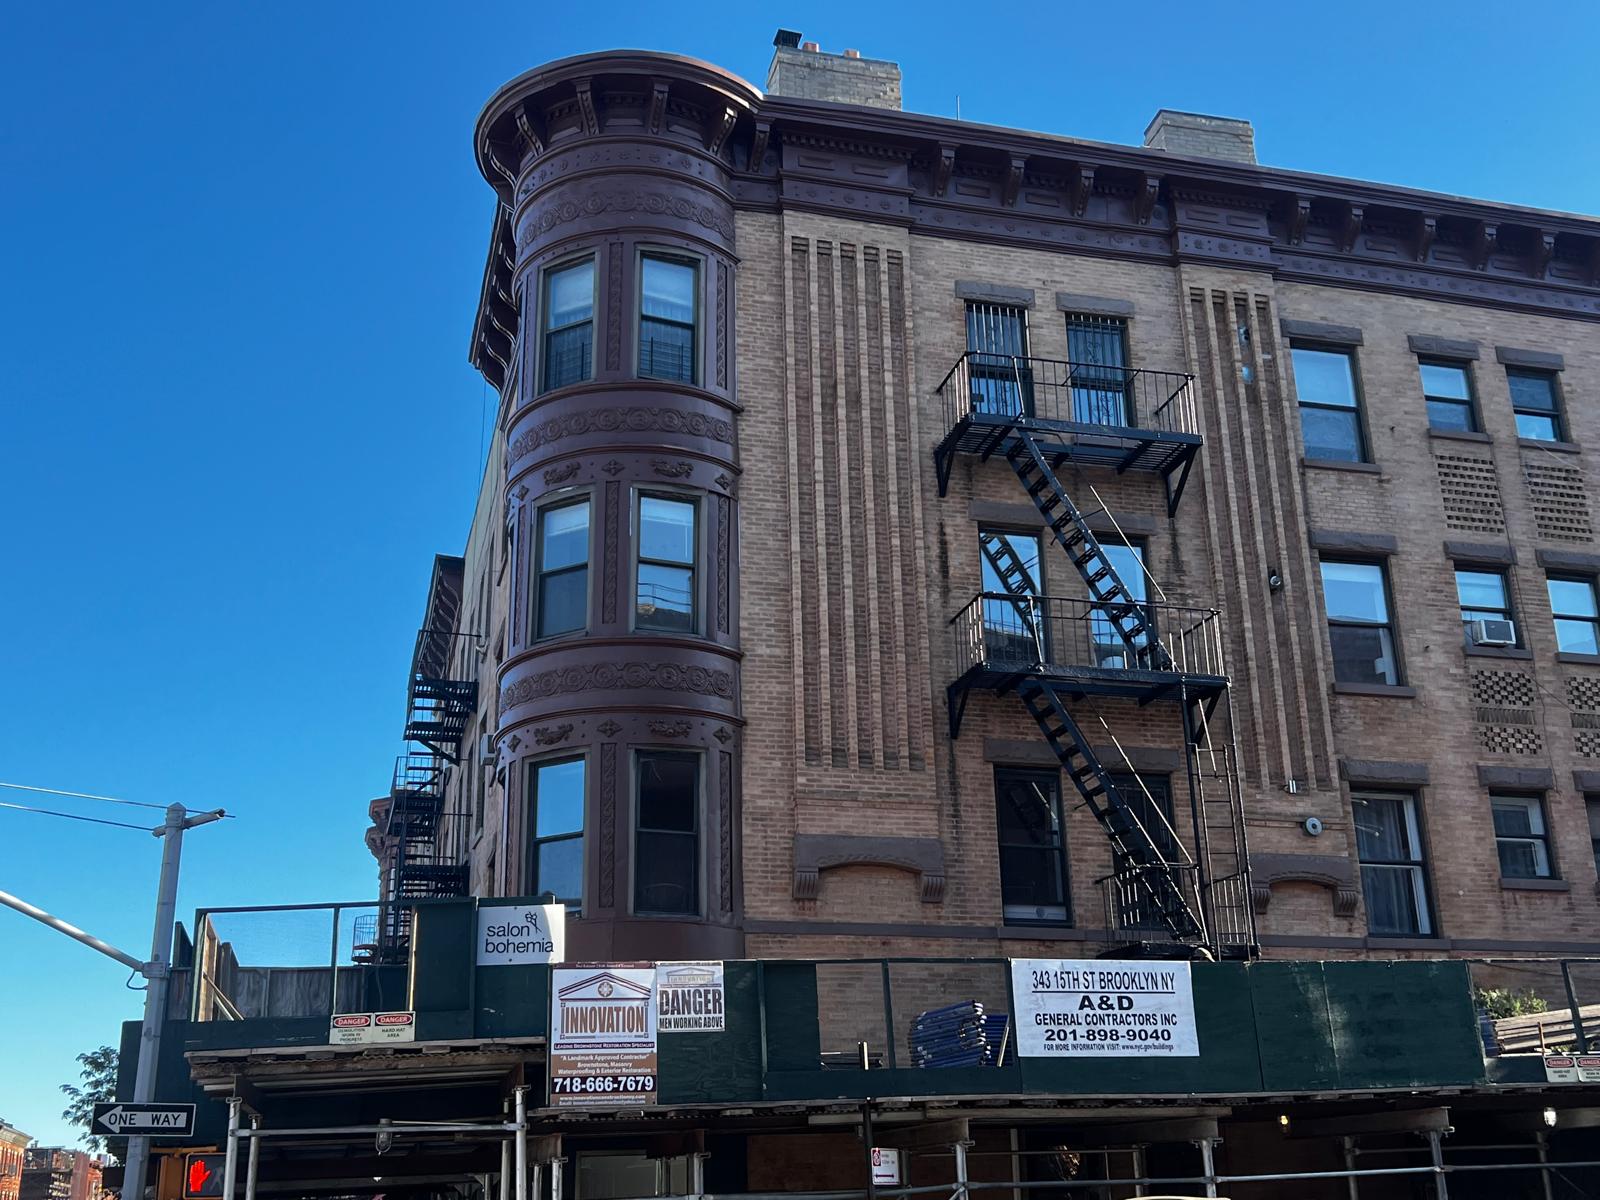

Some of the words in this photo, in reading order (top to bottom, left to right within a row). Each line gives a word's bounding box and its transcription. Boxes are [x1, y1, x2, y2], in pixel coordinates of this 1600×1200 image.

[486, 921, 530, 937] salon
[485, 937, 554, 954] bohemia
[1032, 970, 1051, 989] 343
[1053, 971, 1080, 990] 15TH
[1082, 971, 1096, 990] ST
[1099, 971, 1159, 991] BROOKLYN
[1161, 972, 1175, 991] NY
[660, 988, 723, 1016] DANGER
[1078, 995, 1134, 1011] A&D
[338, 1018, 366, 1026] DANGER
[380, 1016, 408, 1024] DANGER
[564, 1005, 645, 1034] INNOVATION
[660, 1017, 673, 1030] MEN
[673, 1016, 703, 1029] WORKING
[703, 1015, 723, 1029] ABOVE
[1035, 1013, 1083, 1026] GENERAL
[1084, 1013, 1158, 1026] CONTRACTORS
[1160, 1013, 1178, 1026] INC
[1044, 1028, 1172, 1042] 201-898-9040
[1043, 1043, 1055, 1051] FOR
[1056, 1043, 1070, 1051] MORE
[1070, 1043, 1105, 1051] INFORMATION
[594, 1054, 620, 1062] Approved
[553, 1075, 654, 1093] 718-666-7679
[108, 1113, 137, 1126] ONE
[151, 1113, 182, 1126] WAY
